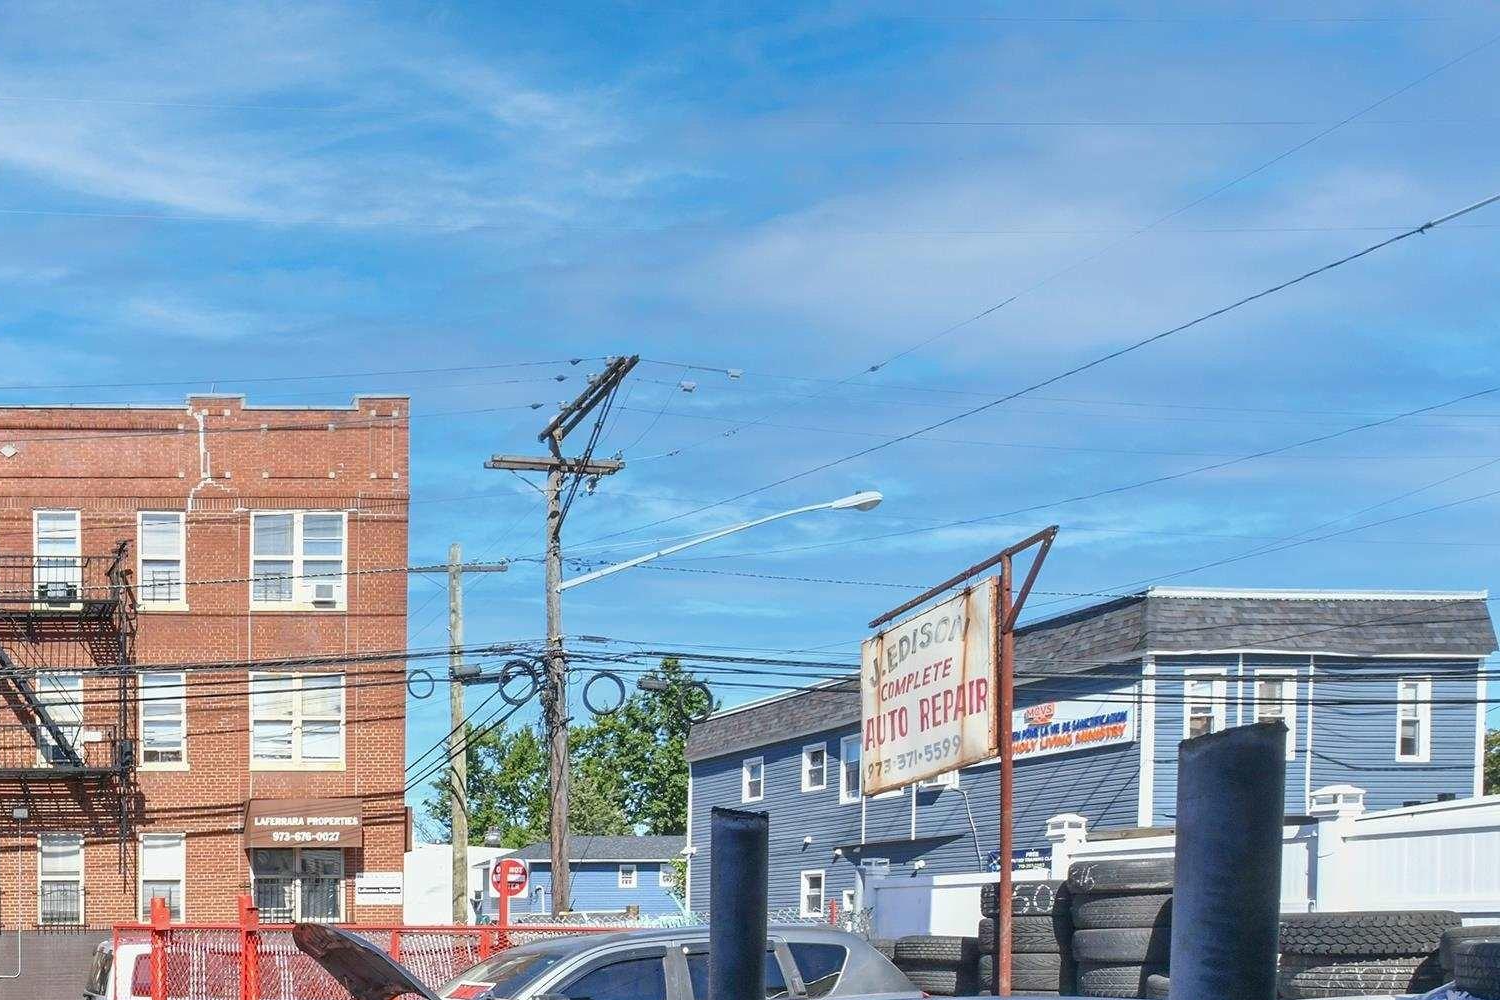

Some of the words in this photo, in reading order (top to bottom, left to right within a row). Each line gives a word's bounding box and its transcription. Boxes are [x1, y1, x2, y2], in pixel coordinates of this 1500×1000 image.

[881, 656, 953, 702] COMPLETE
[864, 705, 908, 752] AUTO
[919, 677, 988, 732] REPAIR
[1040, 725, 1049, 736] LA
[254, 817, 305, 826] LAFERRARA
[306, 816, 359, 826] PROPERTIES
[273, 831, 340, 842] 973-676-0027
